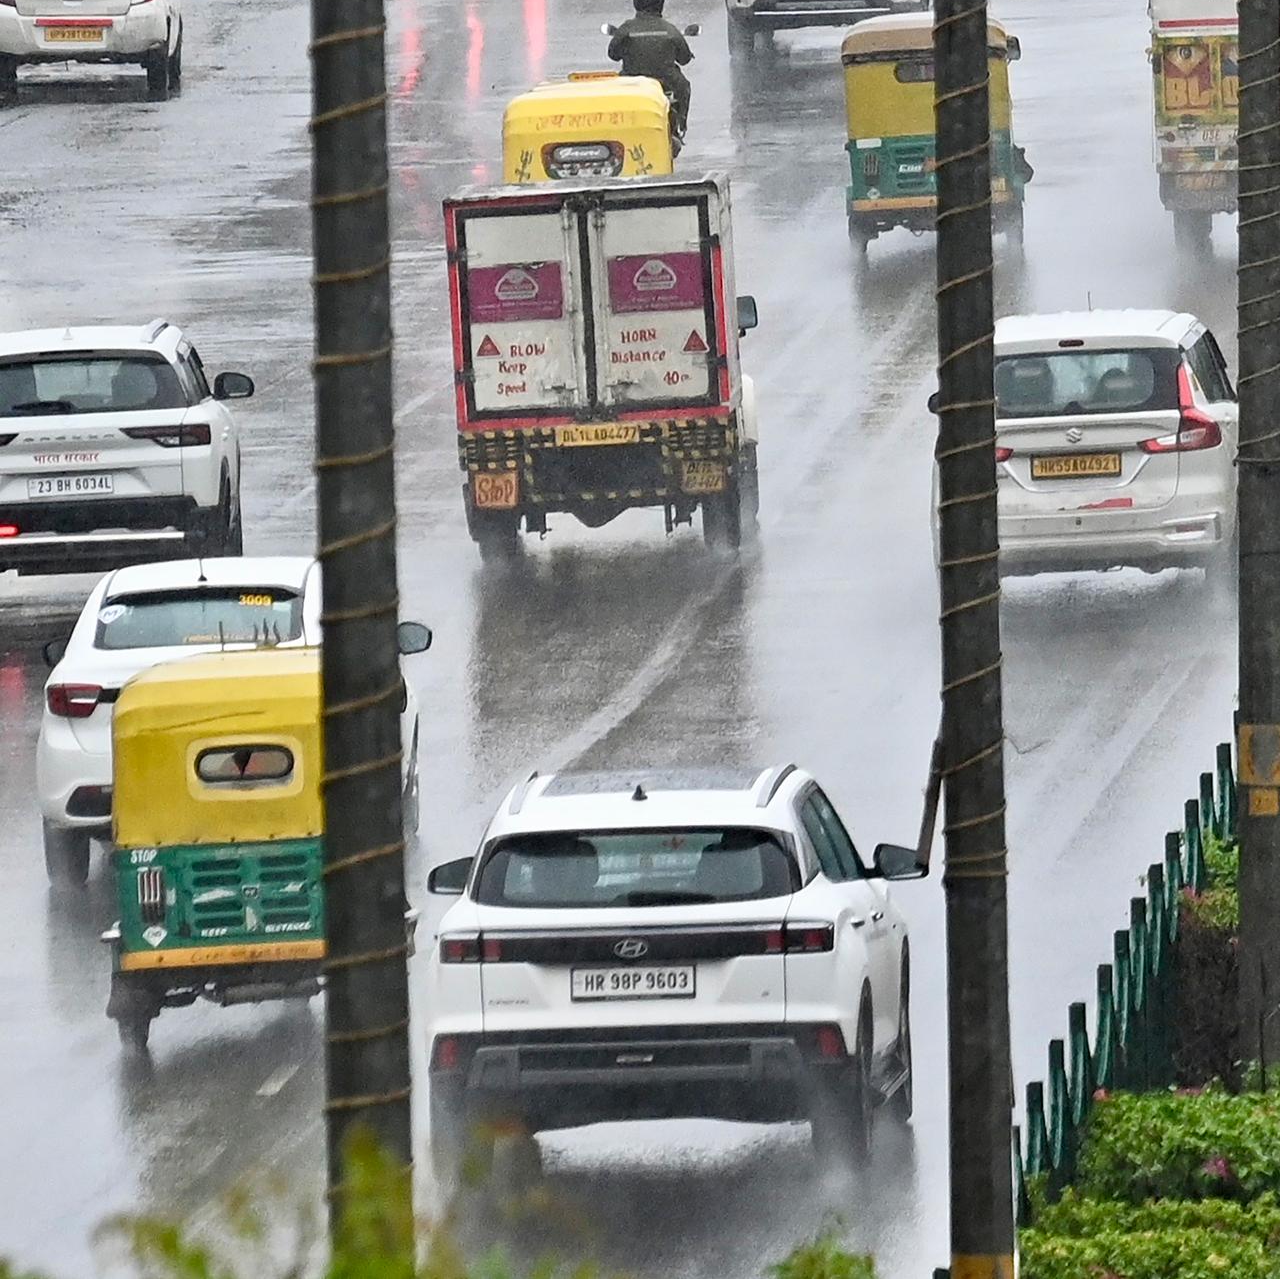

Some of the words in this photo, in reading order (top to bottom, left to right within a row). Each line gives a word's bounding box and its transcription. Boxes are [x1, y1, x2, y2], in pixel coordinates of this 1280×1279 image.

[510, 344, 545, 358] BLOW
[621, 328, 657, 343] HORN
[34, 453, 60, 464] भारत
[64, 452, 100, 463] सरकार
[38, 480, 52, 494] 23
[57, 479, 71, 492] BH
[75, 477, 111, 491] 6034L
[131, 850, 157, 864] STOP
[584, 974, 605, 992] HR
[610, 971, 640, 990] 98P
[646, 970, 689, 989] 9603
